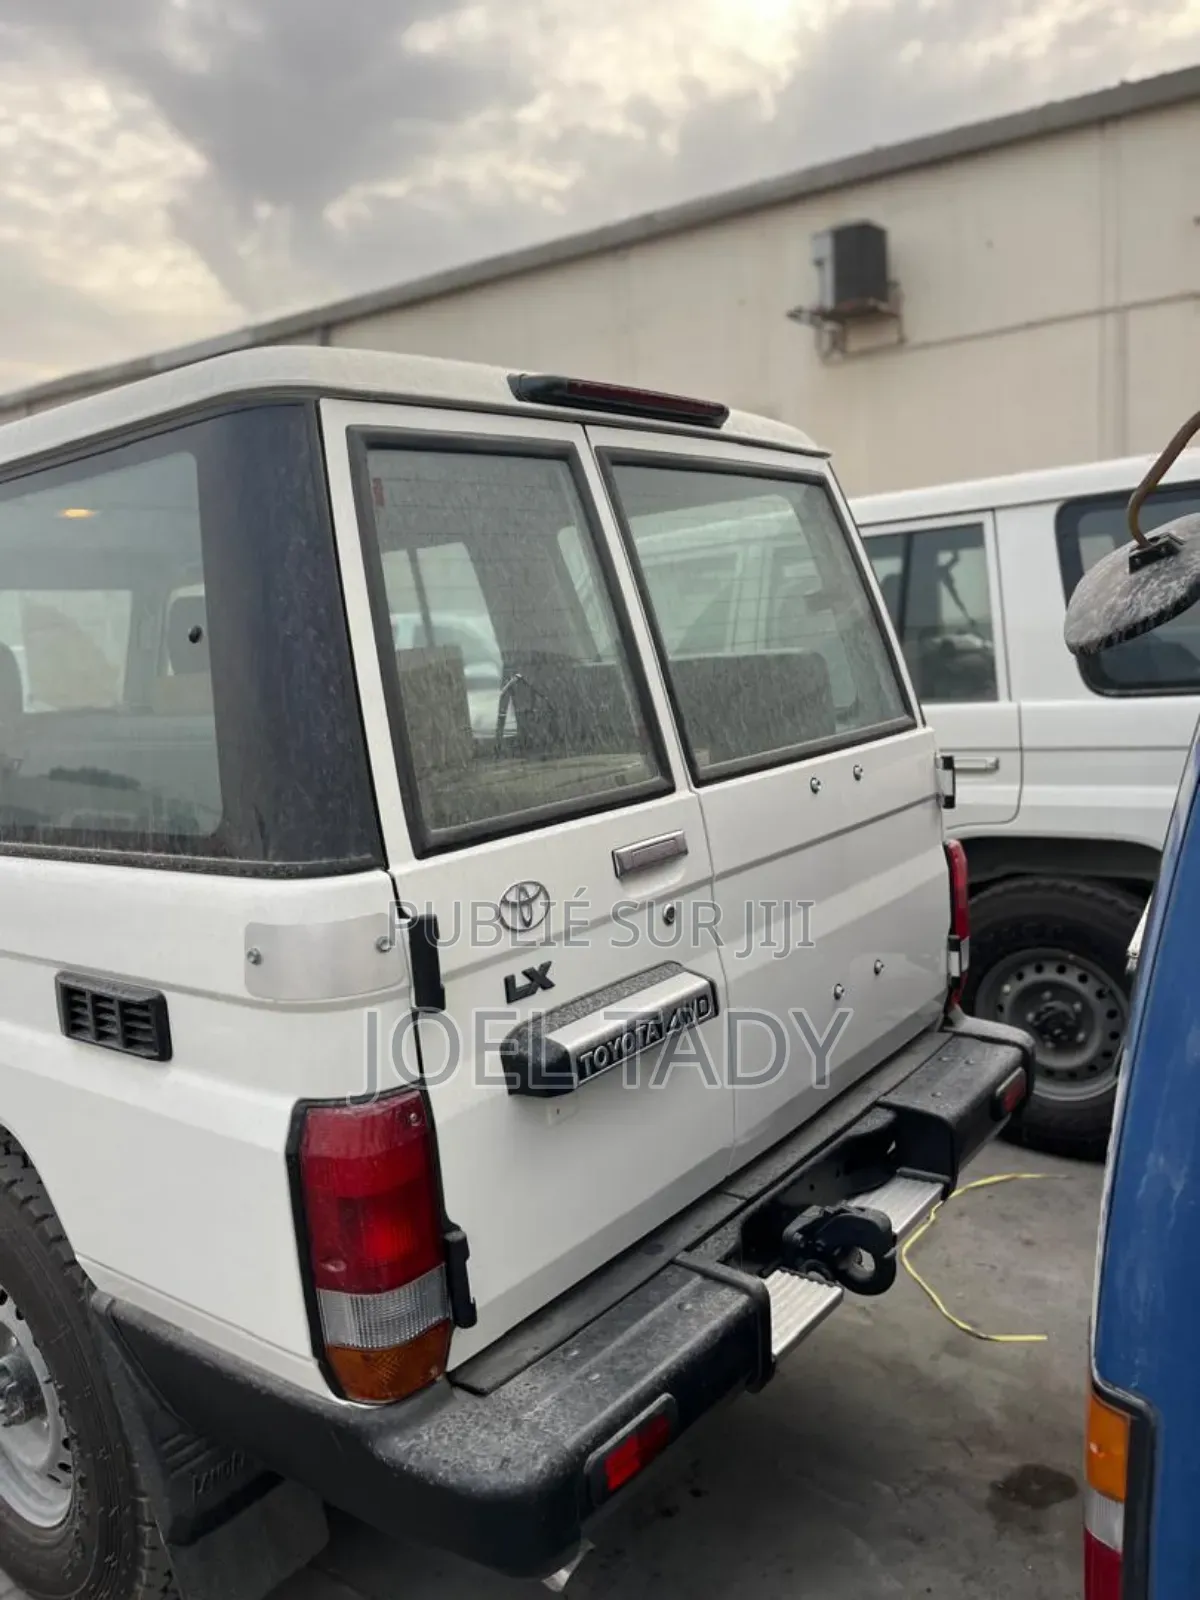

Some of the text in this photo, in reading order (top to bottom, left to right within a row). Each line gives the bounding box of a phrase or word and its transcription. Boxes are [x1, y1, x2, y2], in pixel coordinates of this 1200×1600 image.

[504, 960, 555, 1004] LX
[579, 994, 712, 1077] TOYOTA 4WD
